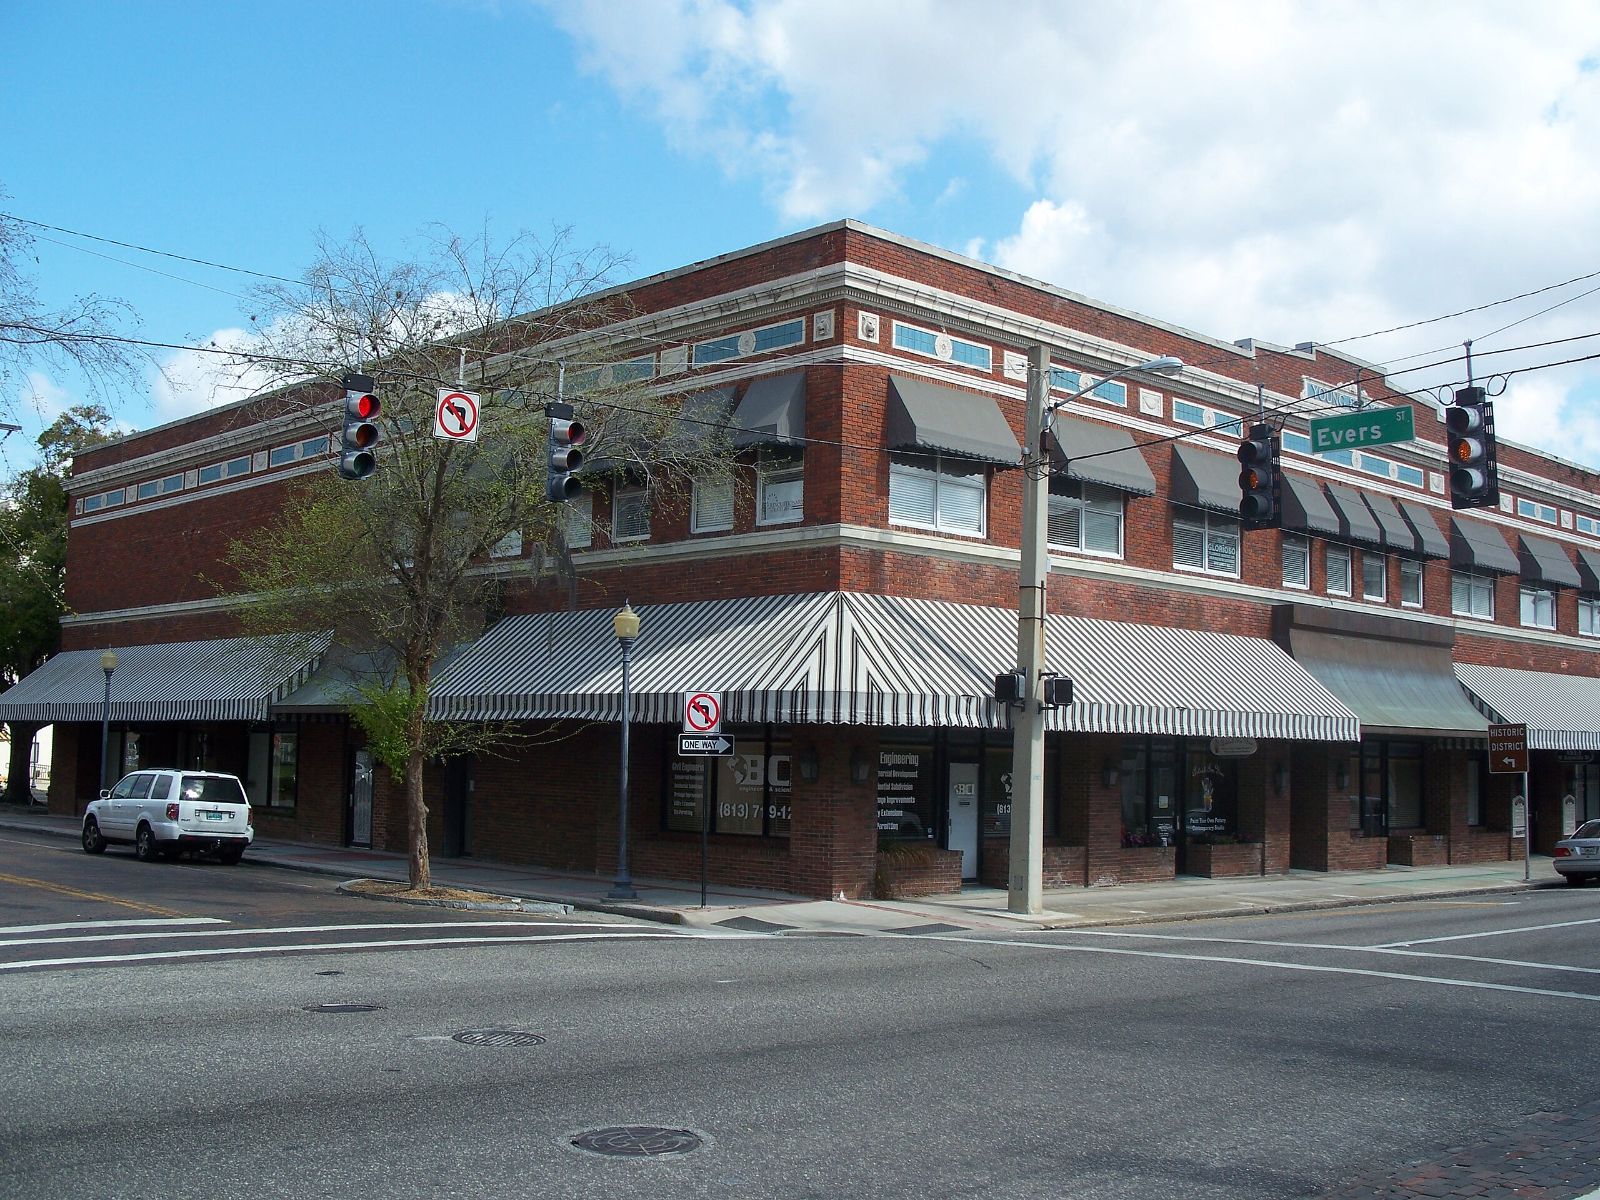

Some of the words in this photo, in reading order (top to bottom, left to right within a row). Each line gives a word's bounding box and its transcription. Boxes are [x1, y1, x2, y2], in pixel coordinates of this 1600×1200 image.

[1317, 425, 1382, 447] Evers
[1396, 411, 1405, 421] ST
[1490, 727, 1525, 737] HISTORIC
[684, 740, 700, 749] ONE
[702, 740, 717, 749] WAY
[1491, 741, 1524, 751] DISTRICT
[880, 752, 919, 767] Engineering
[741, 754, 793, 787] BC
[720, 801, 749, 820] (813)
